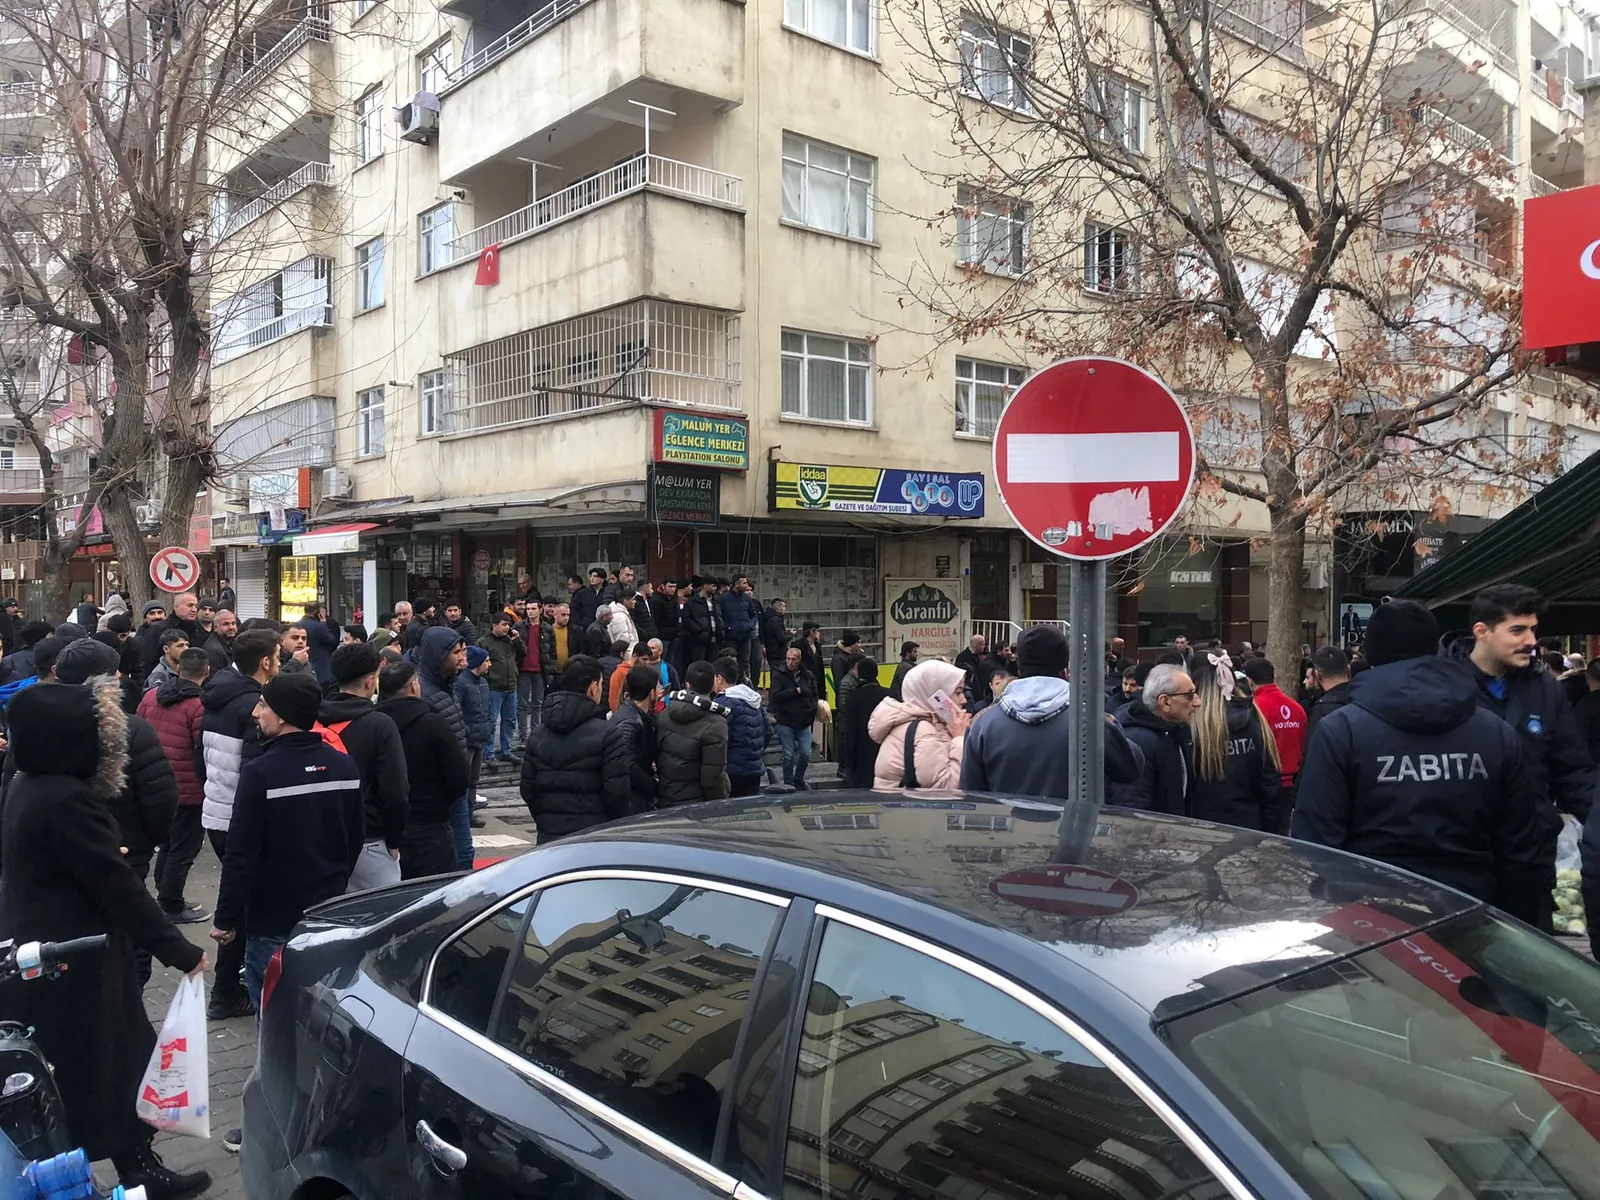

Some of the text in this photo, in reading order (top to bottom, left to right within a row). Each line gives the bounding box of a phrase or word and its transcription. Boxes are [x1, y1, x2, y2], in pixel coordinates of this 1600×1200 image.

[682, 420, 730, 434] MALUM YER
[708, 438, 745, 452] MERKEZİ
[665, 450, 741, 464] PLAYSTATION SALONU
[801, 468, 826, 480] iddaa
[906, 473, 951, 484] SAYISAL
[655, 474, 712, 489] M@LUM YER
[659, 488, 675, 497] DEV
[905, 486, 949, 507] LOTO
[894, 601, 951, 620] Karanfil
[911, 625, 952, 638] NARGİLE
[1225, 738, 1255, 755] BITA
[1376, 752, 1489, 782] ZABITA
